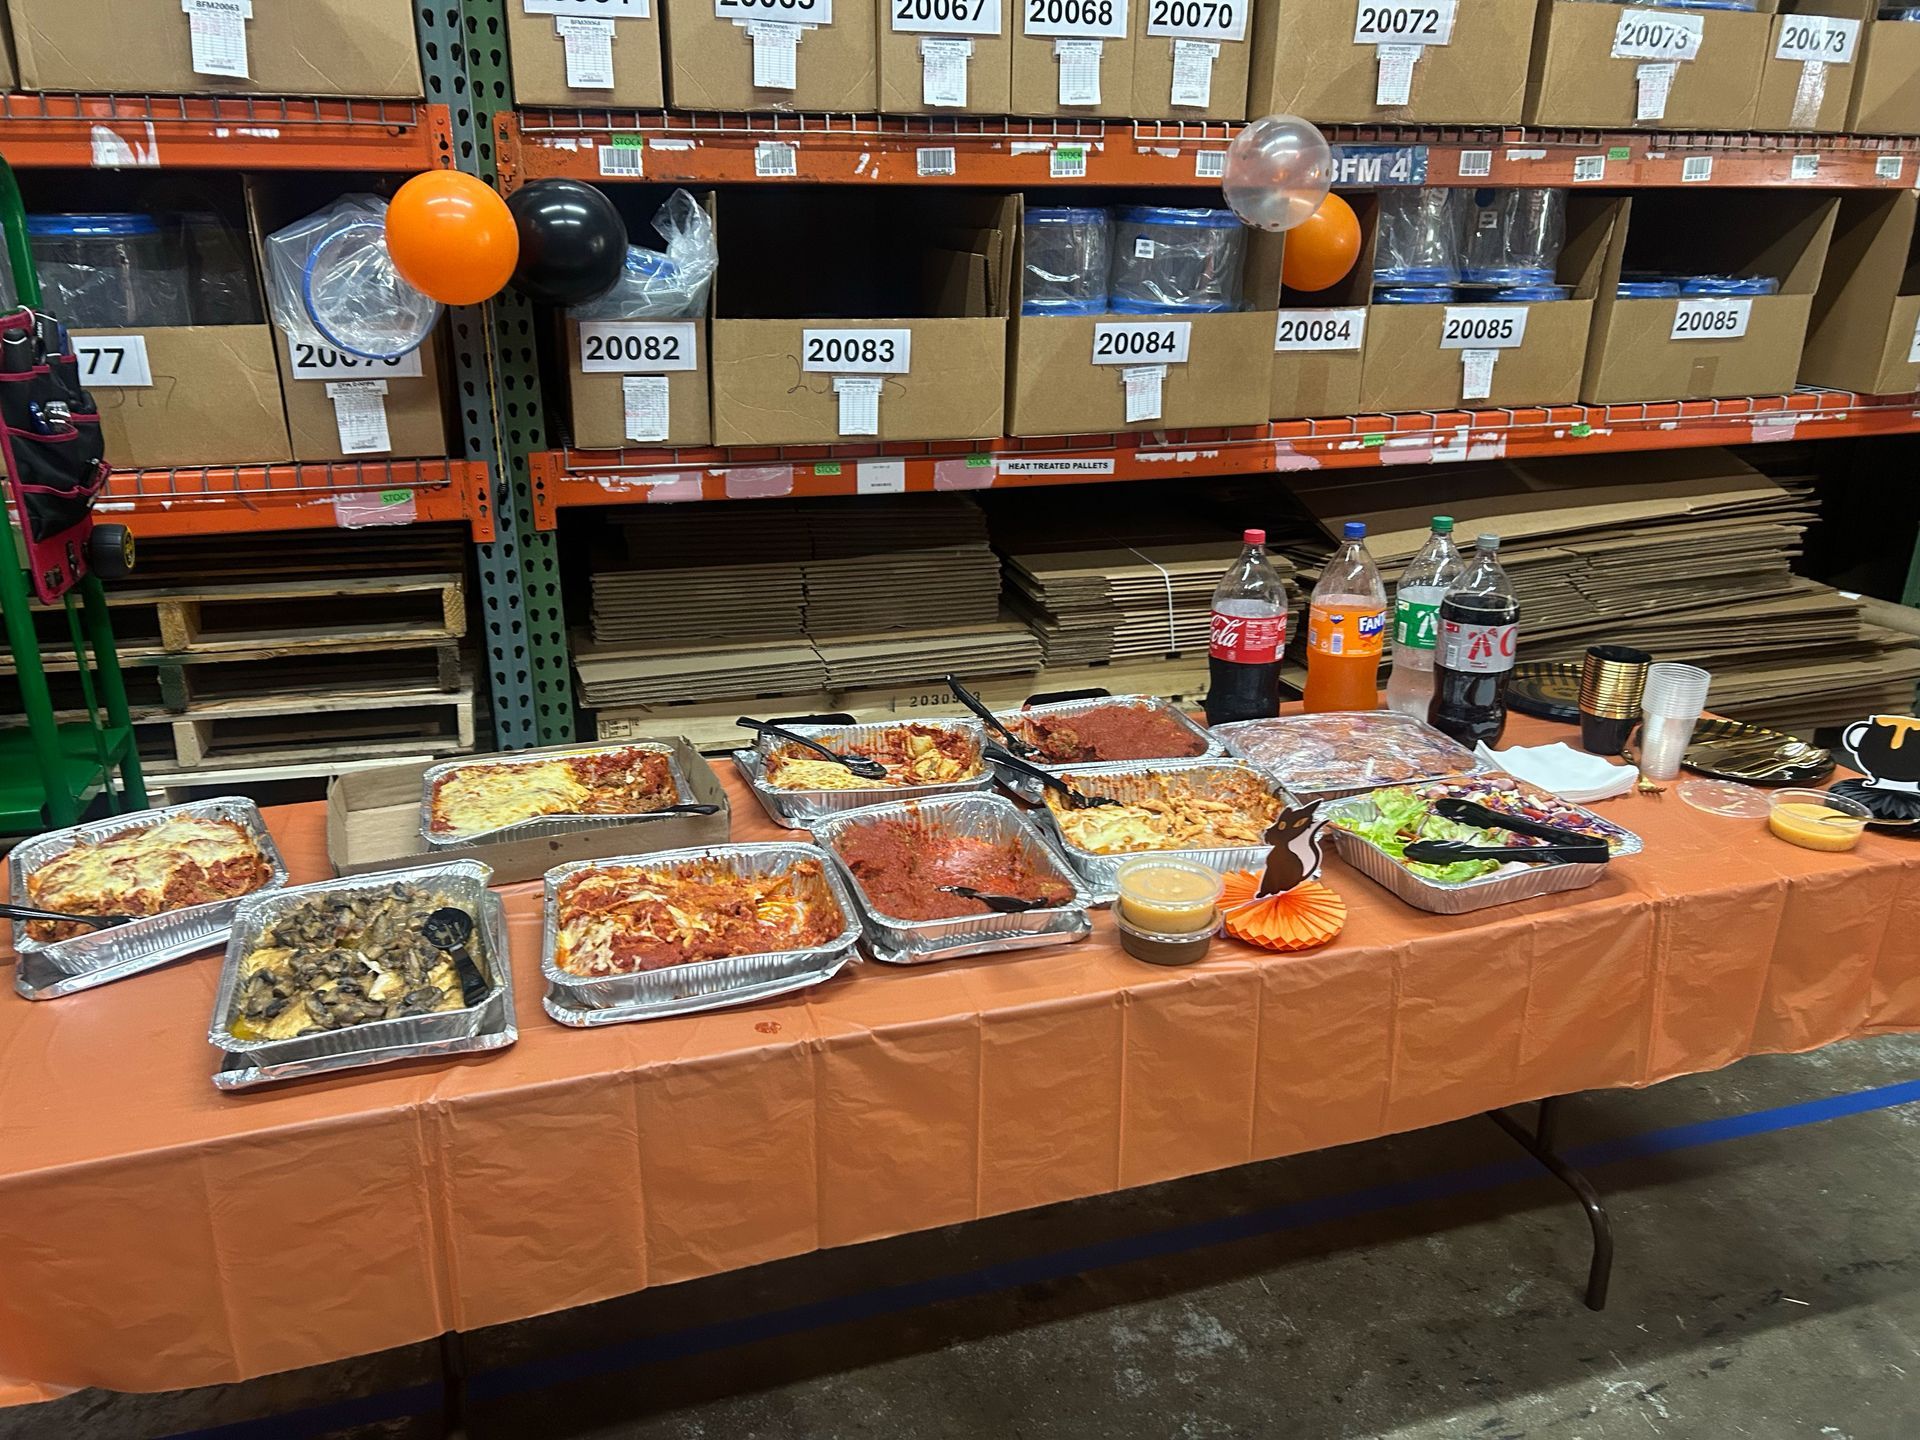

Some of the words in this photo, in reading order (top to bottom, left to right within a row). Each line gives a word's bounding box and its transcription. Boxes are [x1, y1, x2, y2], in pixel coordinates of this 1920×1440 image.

[897, 0, 985, 21] 20067
[1030, 0, 1113, 26] 20068
[1153, 0, 1233, 29] 20070
[1359, 7, 1439, 34] 20072
[1620, 22, 1690, 50] 20073
[1781, 26, 1847, 53] 20073
[615, 137, 642, 146] STOCK
[1058, 150, 1083, 160] STOCK
[1389, 157, 1408, 182] 4
[1279, 319, 1351, 342] 20084
[1445, 318, 1513, 340] 20085
[1675, 310, 1738, 332] 20085
[586, 335, 681, 361] 20082
[807, 338, 895, 363] 20083
[1097, 330, 1176, 355] 20084
[79, 347, 126, 375] 77
[815, 465, 841, 474] STOCK
[967, 457, 991, 466] STOCK
[1008, 462, 1031, 470] HEAT
[1033, 461, 1071, 470] TREATED
[1072, 461, 1109, 470] PALLETS
[383, 491, 411, 502] STOCK
[1210, 614, 1246, 649] ola
[909, 691, 981, 708] 203093
